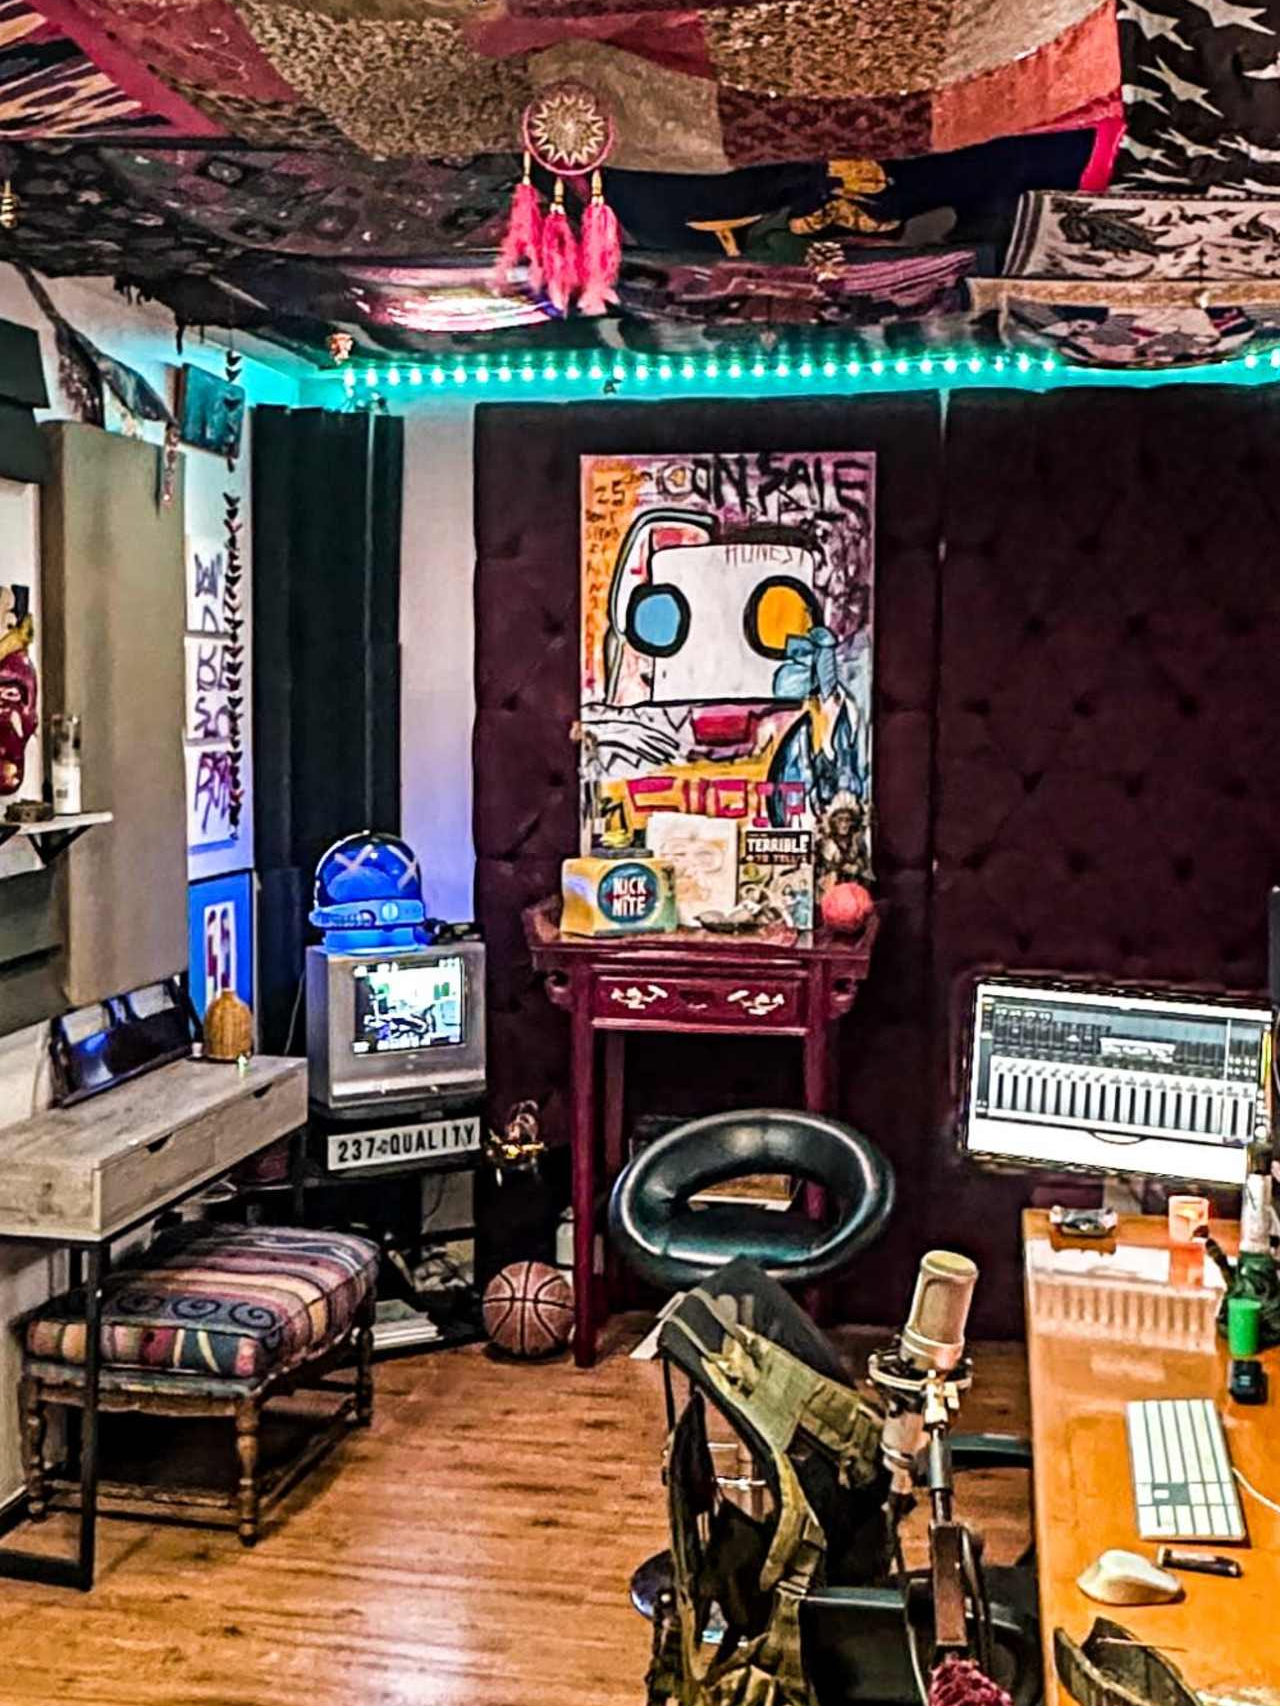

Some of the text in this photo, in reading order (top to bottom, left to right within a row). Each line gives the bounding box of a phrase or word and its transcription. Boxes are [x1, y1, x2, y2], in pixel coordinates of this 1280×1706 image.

[725, 544, 805, 567] HONEST
[746, 834, 809, 853] TERRIBLE
[338, 1137, 375, 1163] 237
[390, 1124, 474, 1155] QUALITY
